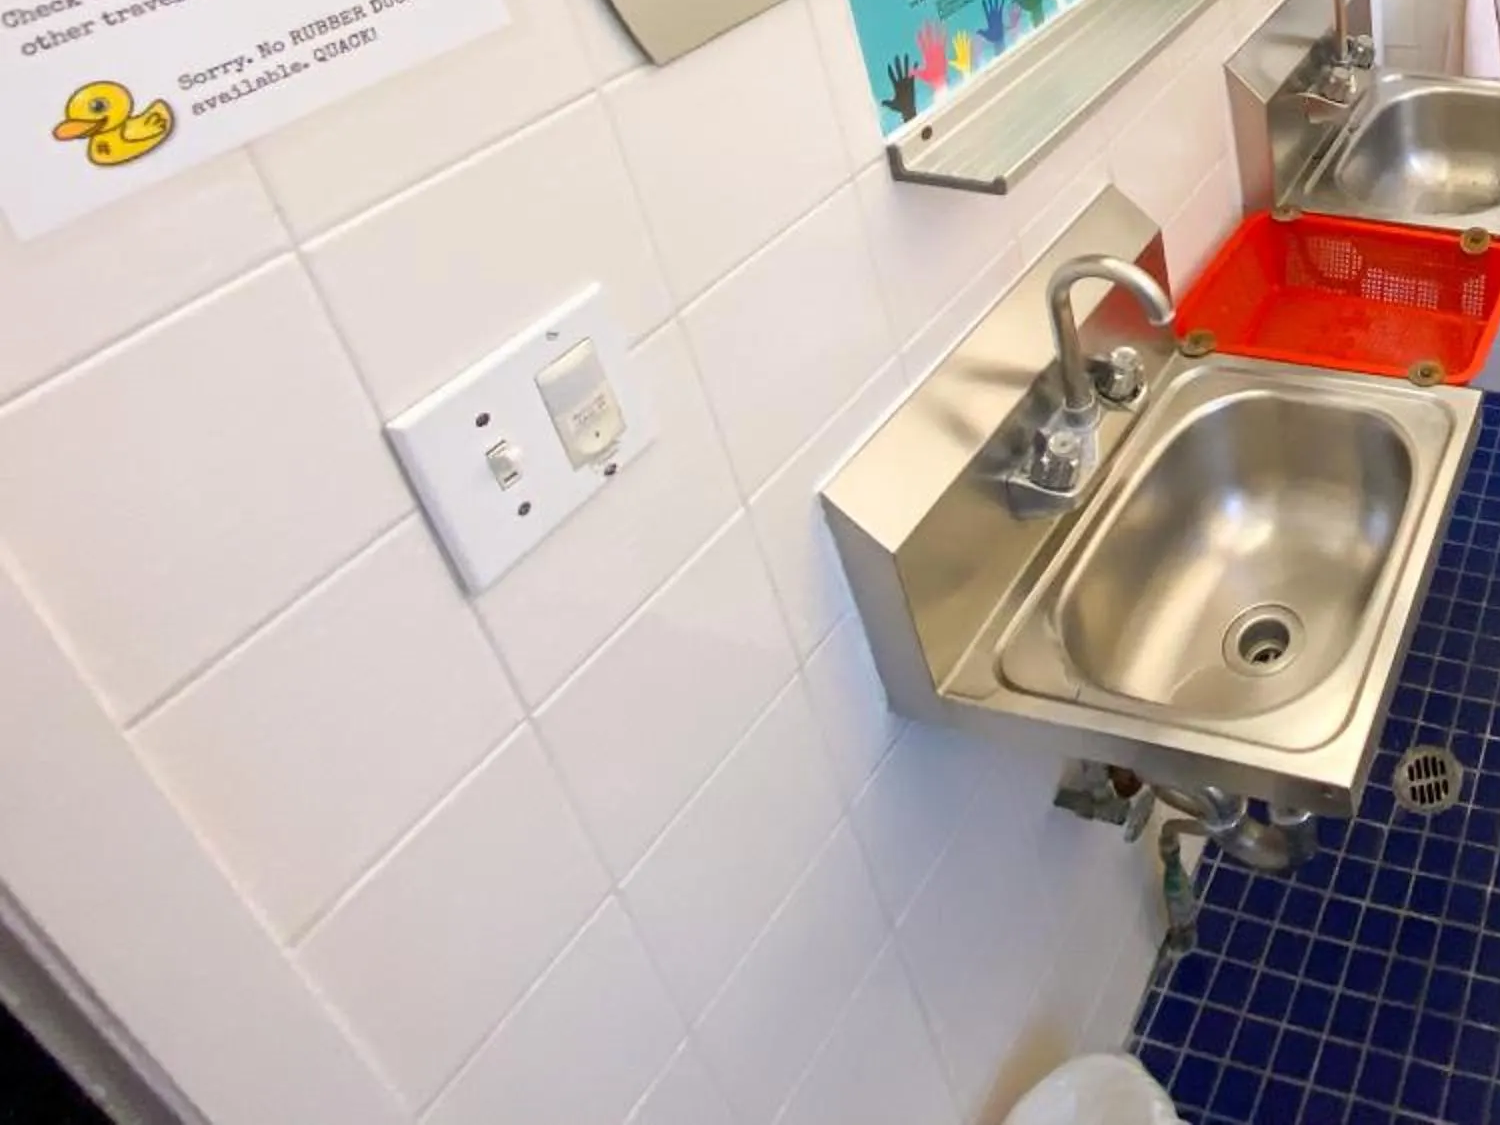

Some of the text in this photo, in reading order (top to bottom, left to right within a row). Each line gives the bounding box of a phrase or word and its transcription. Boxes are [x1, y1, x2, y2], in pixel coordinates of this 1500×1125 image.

[21, 20, 95, 56] other
[177, 53, 254, 91] Sorry.
[256, 39, 285, 59] No
[288, 4, 367, 46] RUBBER
[191, 27, 378, 116] available. QUACK!
